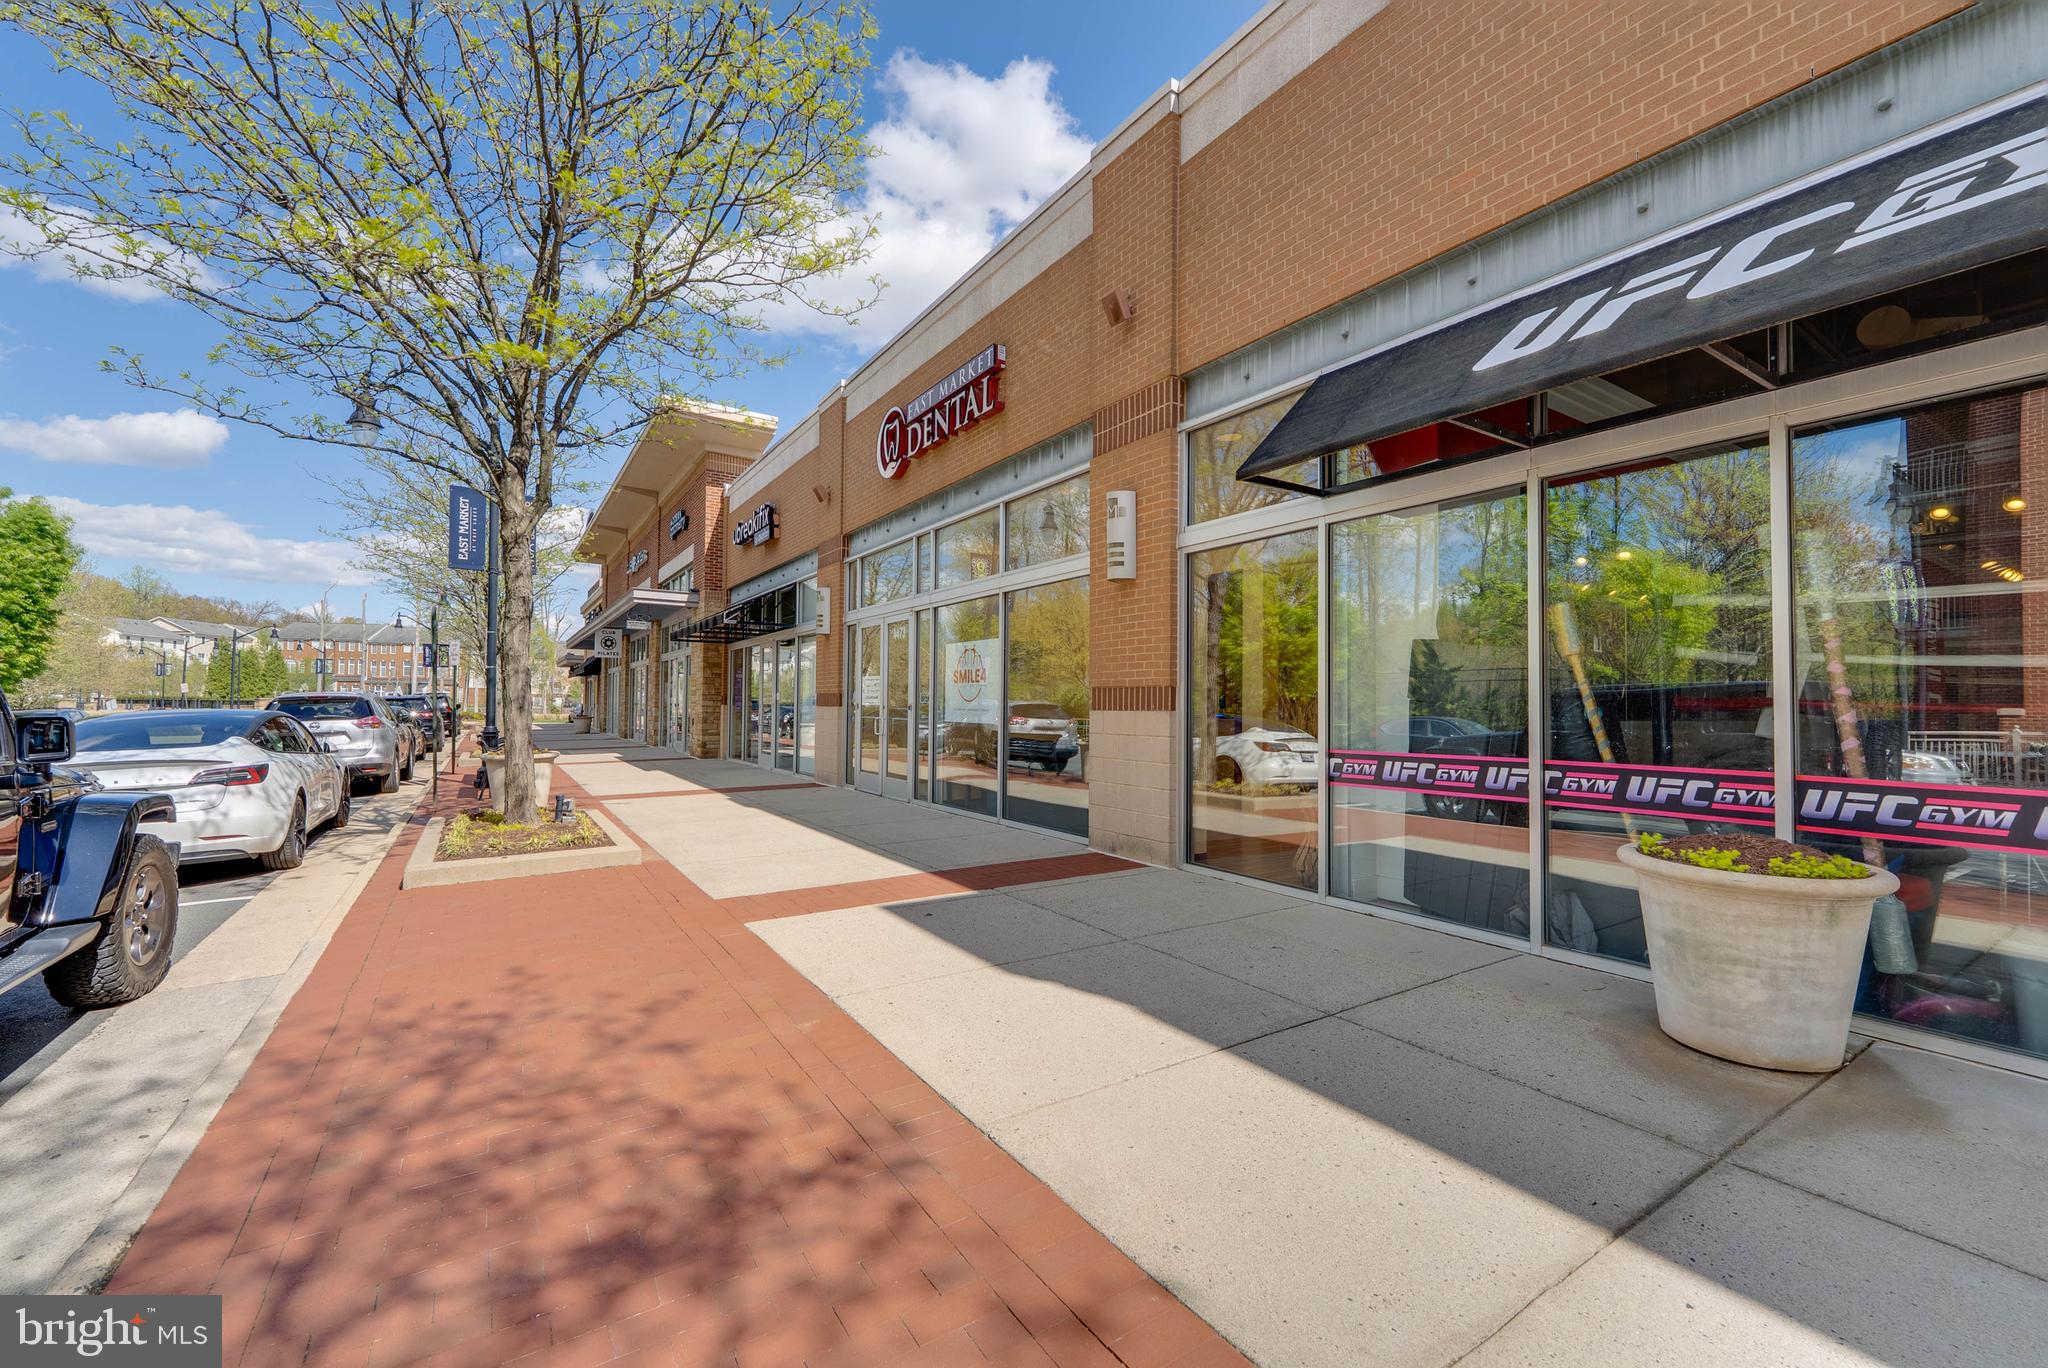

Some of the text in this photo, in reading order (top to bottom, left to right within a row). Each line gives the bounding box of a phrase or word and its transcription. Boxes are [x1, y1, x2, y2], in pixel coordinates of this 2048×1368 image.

[1472, 201, 1855, 371] UFC
[908, 349, 994, 420] EAST MARKET
[906, 375, 995, 458] DENTAL
[458, 497, 470, 560] EAST MARKET
[1342, 763, 1377, 776] GYM
[1382, 761, 1436, 785] UFC
[1435, 768, 1479, 783] GYM
[1562, 778, 1618, 793] GYM
[1626, 776, 1714, 807] UFC
[1713, 788, 1775, 807] GYM
[1800, 788, 1919, 827] UFC
[1918, 805, 2018, 829] GYM
